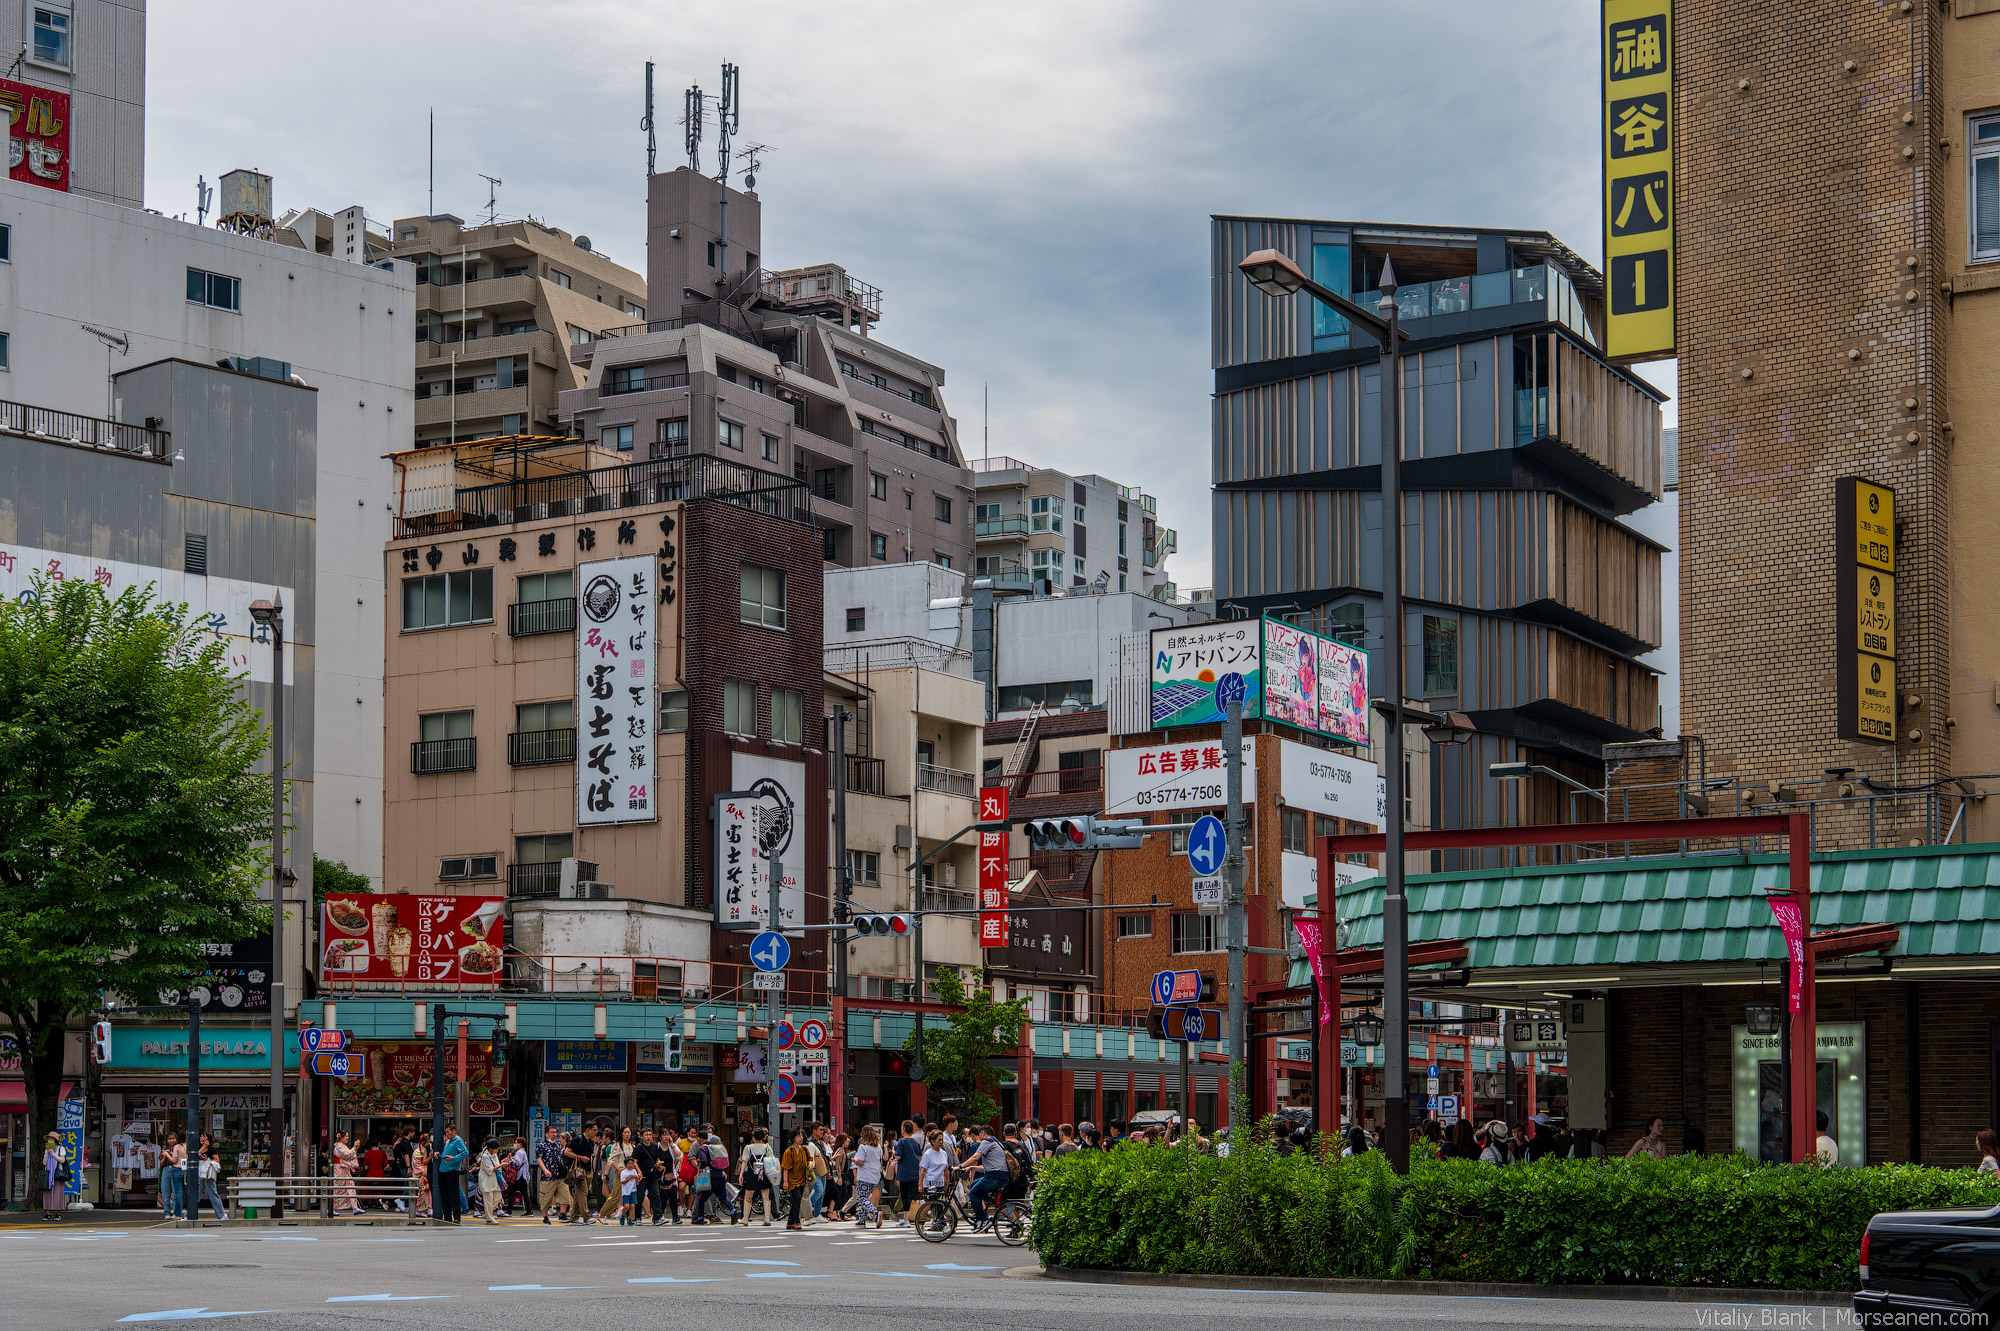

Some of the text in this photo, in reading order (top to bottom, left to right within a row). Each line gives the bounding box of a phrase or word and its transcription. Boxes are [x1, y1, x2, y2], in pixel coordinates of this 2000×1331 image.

[1614, 24, 1665, 305] 神谷バー
[660, 515, 676, 605] 中山ビル
[628, 572, 649, 651] 生そば
[1860, 608, 1890, 630] レストラン
[584, 628, 619, 658] 名代
[1168, 630, 1246, 649] 自然エネルギーの
[1265, 621, 1299, 647] TVアニメ
[1864, 633, 1887, 651] カミヤ
[1177, 645, 1257, 669] アドバンス
[1319, 640, 1351, 664] TVアニメ
[1861, 700, 1891, 714] デンキブランの
[1861, 717, 1891, 736] 神谷バー
[586, 664, 619, 812] 富士そば
[1138, 747, 1221, 775] 広告募集
[1310, 761, 1352, 784] 03-5774-7506
[629, 785, 647, 798] 24
[1137, 785, 1222, 804] 03-5774-7506
[628, 799, 648, 810] 時間
[726, 803, 745, 820] 名代
[726, 824, 744, 904] 富士そば
[983, 797, 1000, 939] 丸勝不動産
[418, 901, 432, 980] KEBAB
[432, 903, 455, 980] ケバブ
[1042, 933, 1072, 955] 西山
[1162, 976, 1170, 996] 6
[1184, 1015, 1202, 1034] 463
[1515, 1024, 1567, 1040] 神谷
[142, 1040, 266, 1055] PALETE PLAZA
[309, 1031, 317, 1045] 6
[557, 1041, 616, 1050] 賃貸・売買・管理
[1743, 1039, 1764, 1048] SINCE
[1817, 1037, 1838, 1047] AMIYA
[1840, 1037, 1854, 1046] BAR
[424, 1045, 455, 1055] ケブ
[557, 1052, 616, 1061] 設計・リフォーム
[651, 1051, 664, 1059] SMI
[331, 1058, 347, 1071] 463
[149, 1095, 269, 1108] Koda フィルム入荷!!
[1442, 1098, 1455, 1114] P
